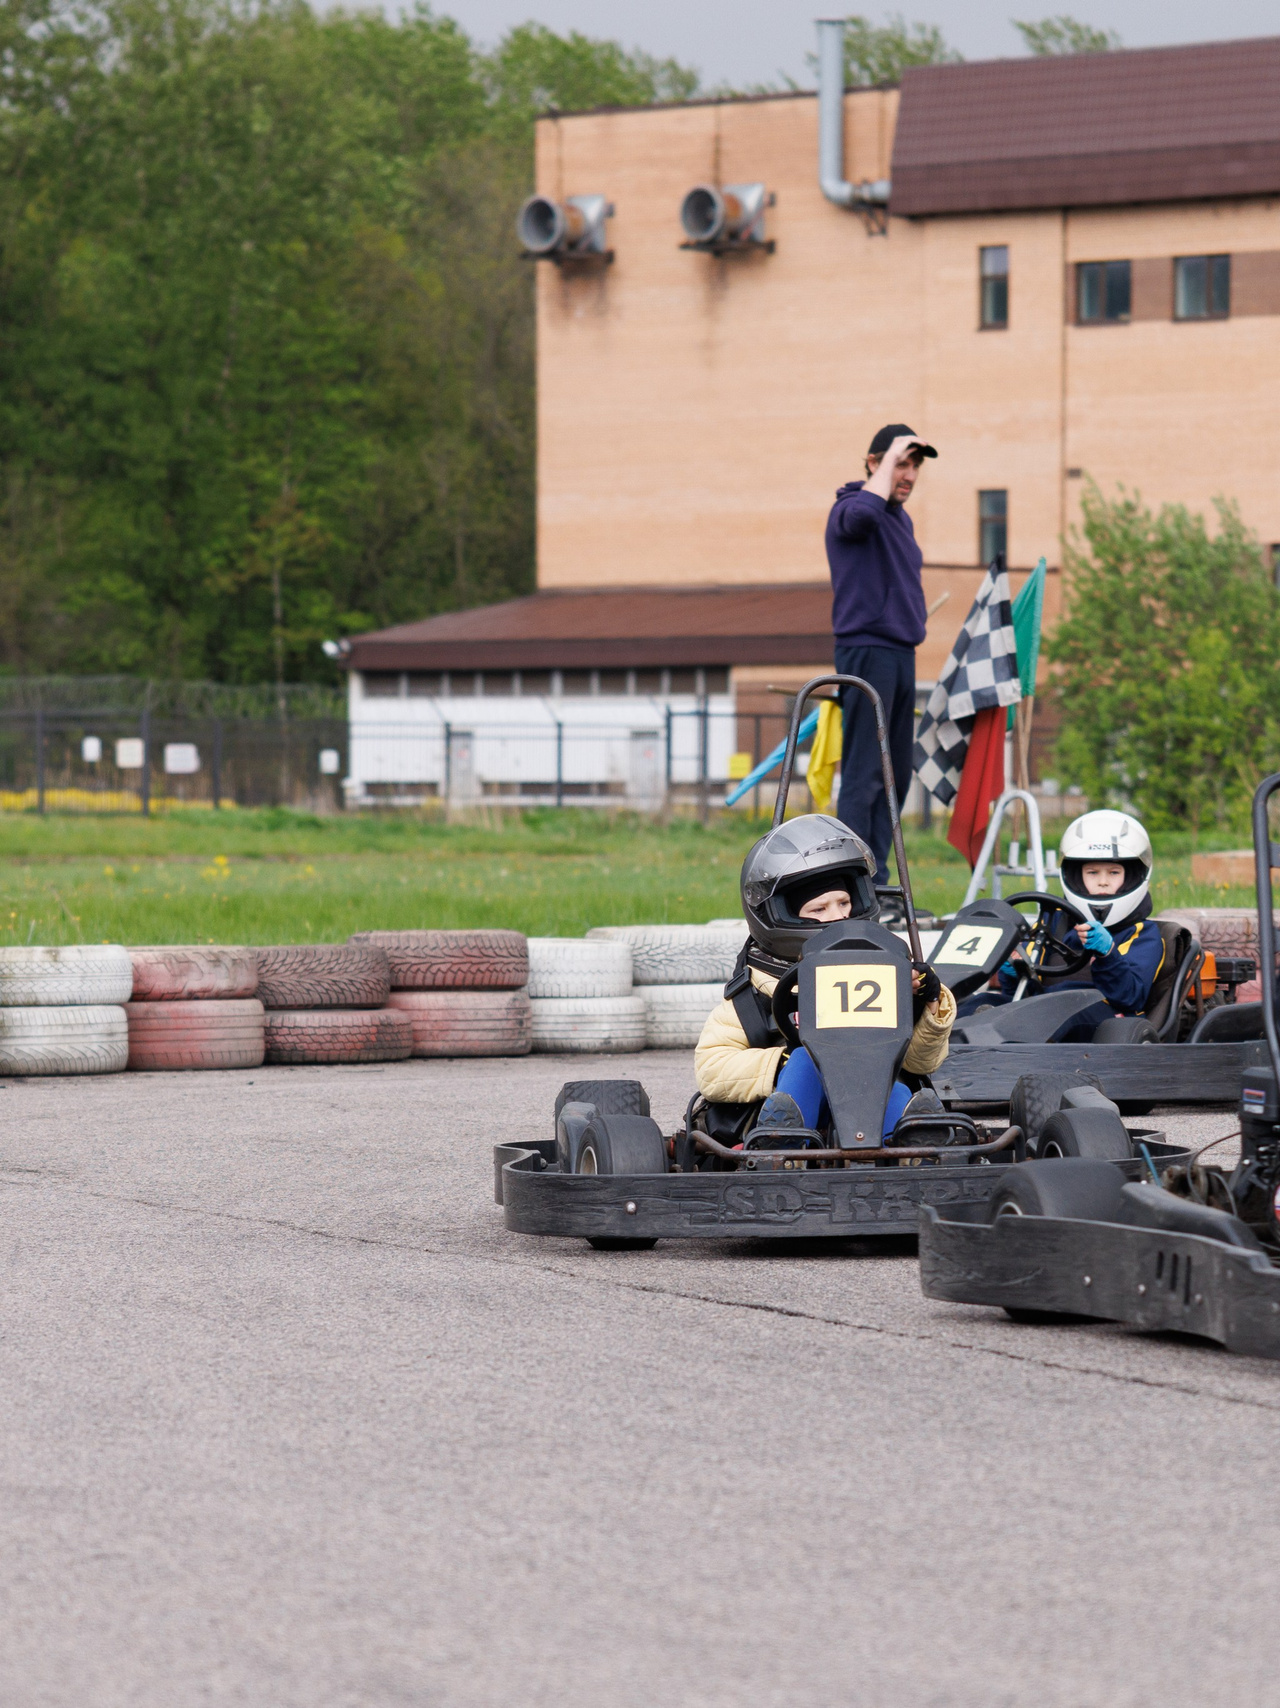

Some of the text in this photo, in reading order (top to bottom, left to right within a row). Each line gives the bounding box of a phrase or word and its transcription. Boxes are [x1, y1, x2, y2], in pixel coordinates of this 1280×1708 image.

[804, 844, 844, 857] LS2
[955, 936, 981, 955] 4
[832, 979, 882, 1013] 12
